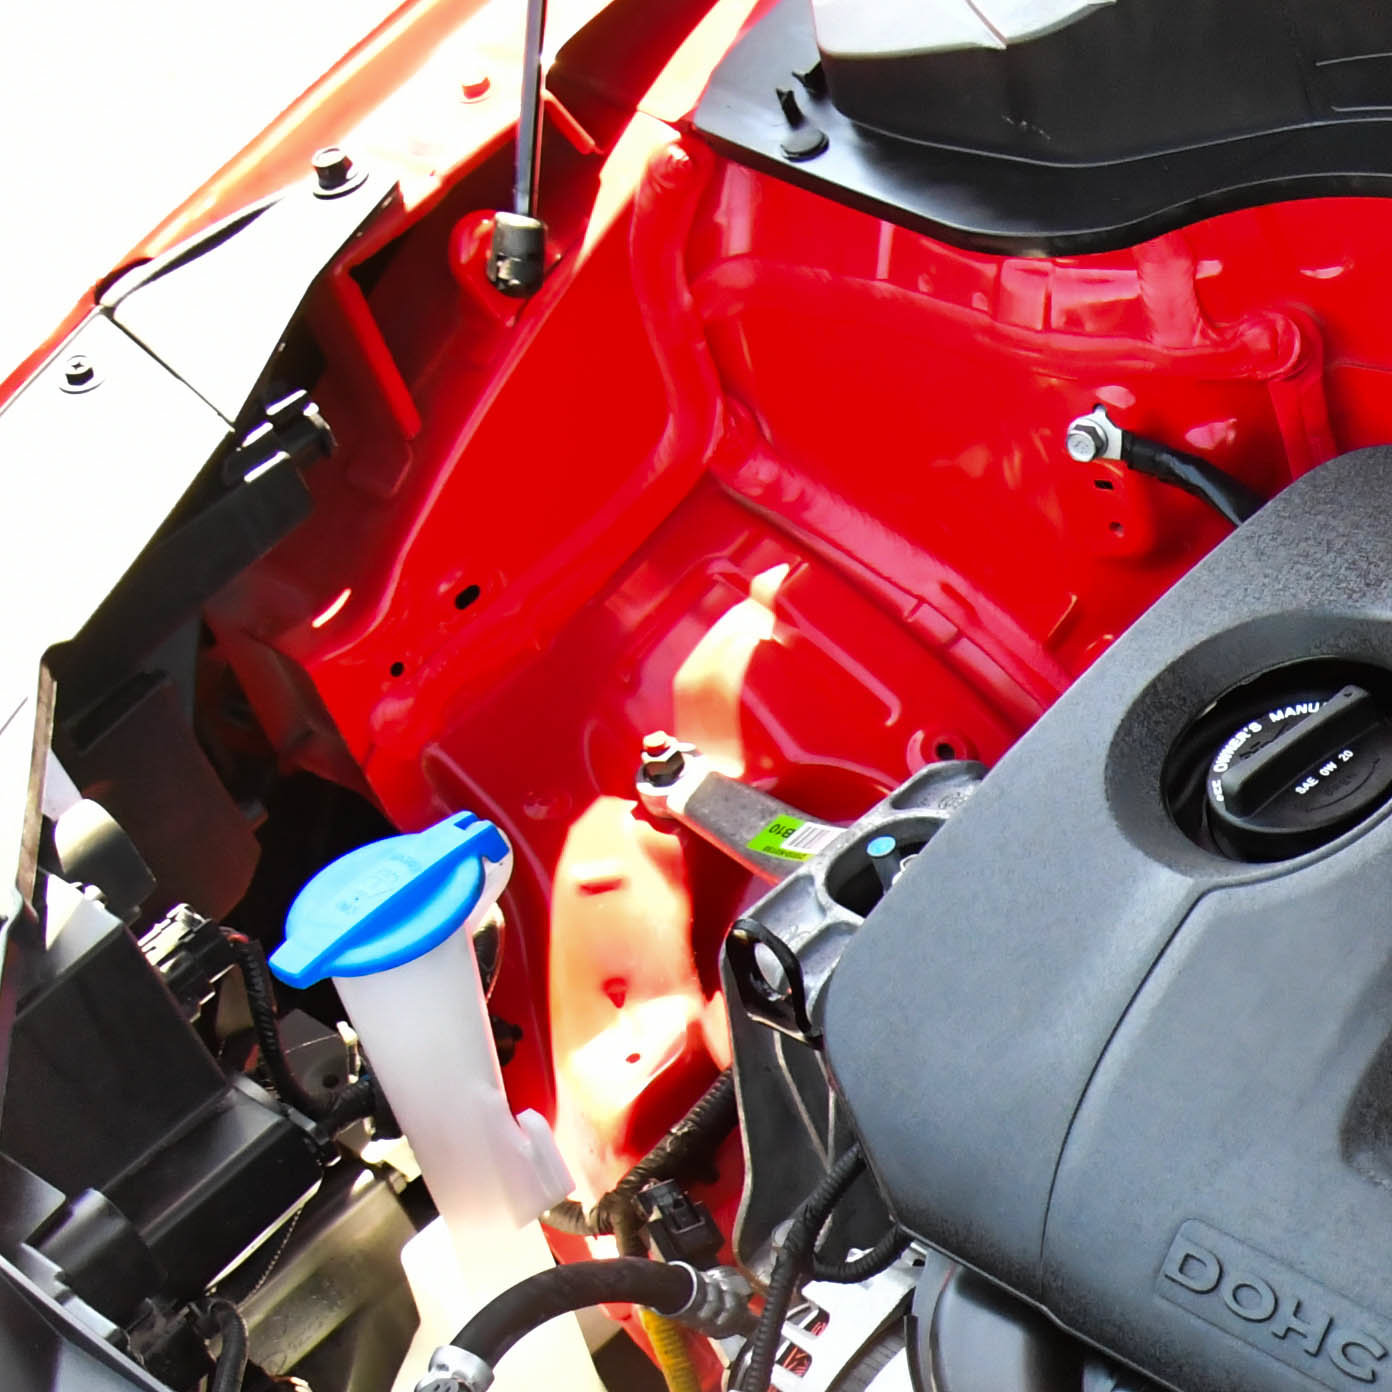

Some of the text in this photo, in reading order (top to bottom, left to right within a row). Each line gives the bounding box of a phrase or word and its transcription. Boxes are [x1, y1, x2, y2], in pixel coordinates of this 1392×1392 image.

[1213, 721, 1262, 773] OWNER'S
[1269, 701, 1328, 723] MANU
[1294, 776, 1320, 796] SAE
[1338, 749, 1355, 763] 20
[1163, 1245, 1389, 1385] DOHC
